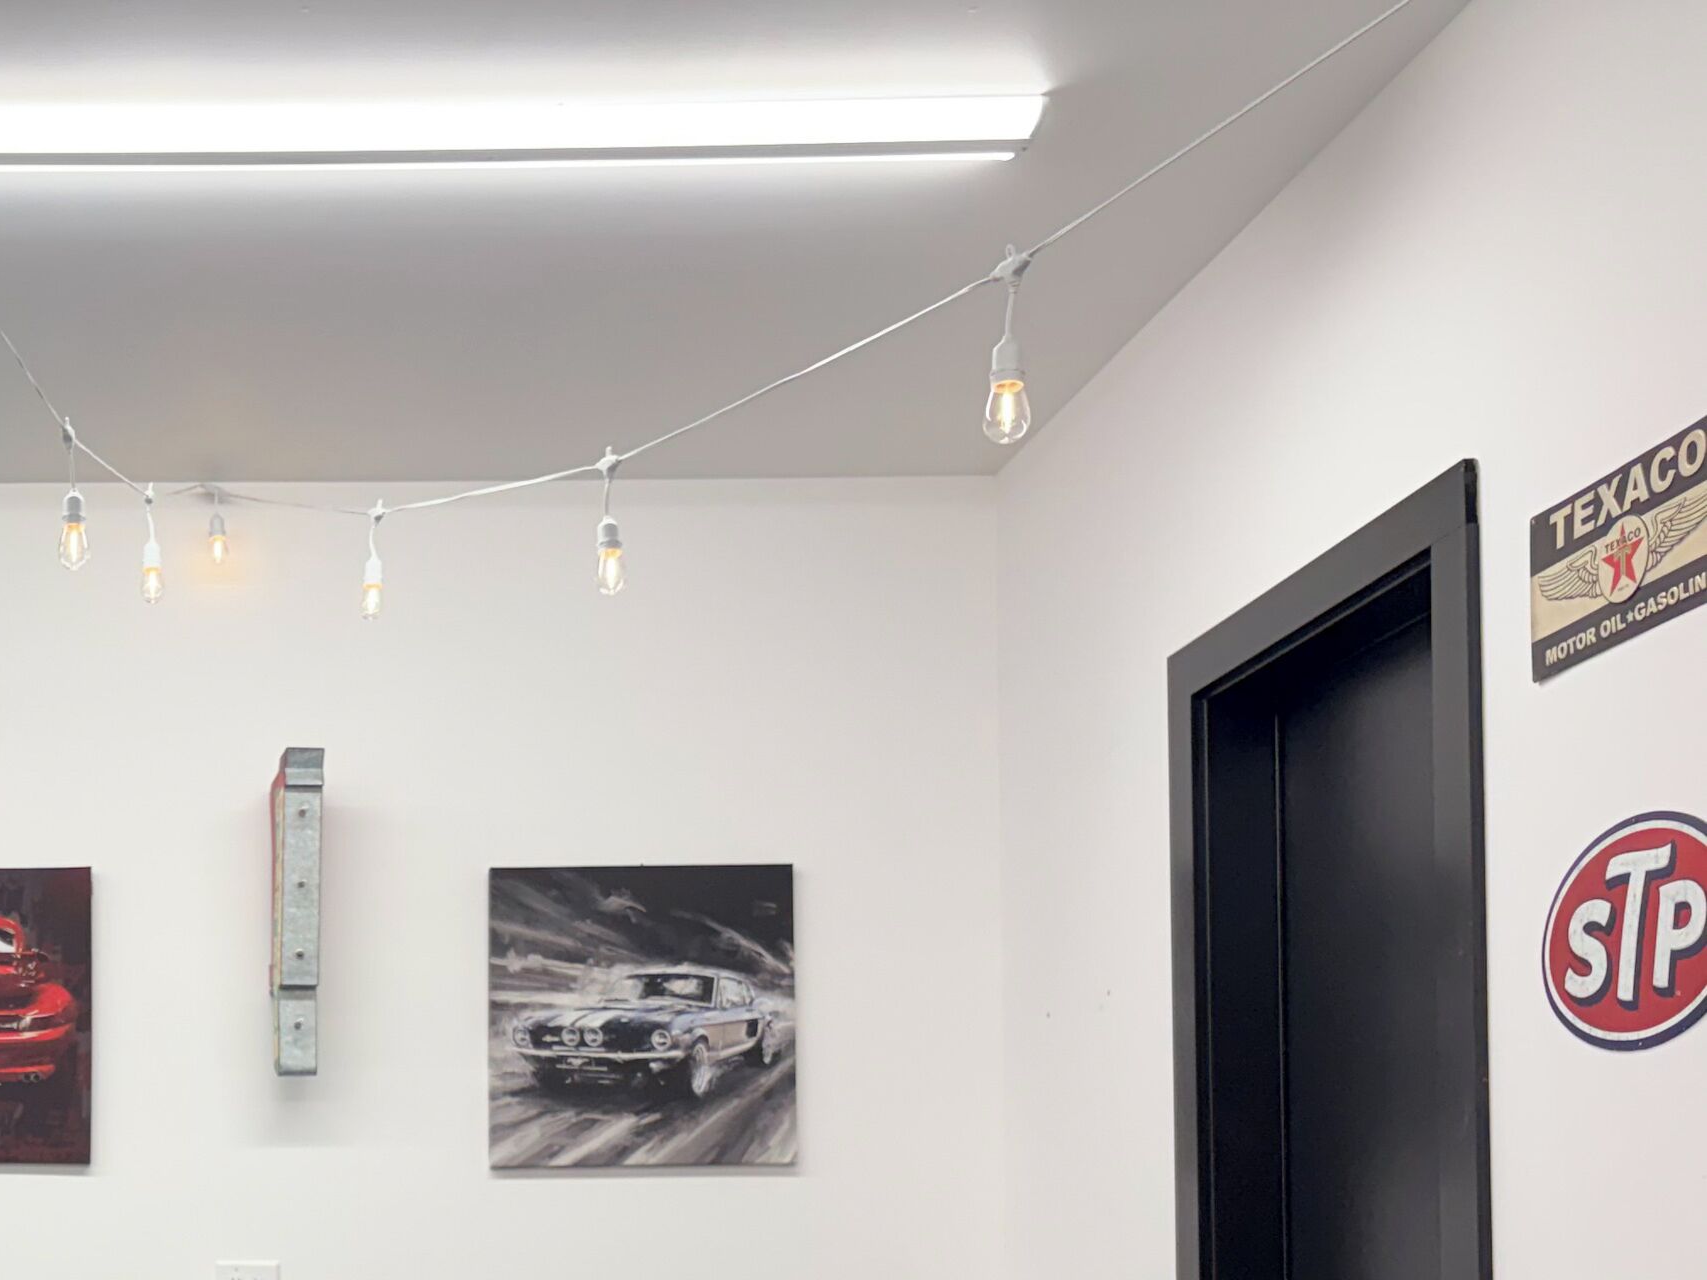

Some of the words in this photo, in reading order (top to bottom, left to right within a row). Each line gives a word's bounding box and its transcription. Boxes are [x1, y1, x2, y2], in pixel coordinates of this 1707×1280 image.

[1549, 428, 1707, 550] TEXACO
[1604, 527, 1641, 554] TEXACO
[1545, 626, 1597, 667] MOTOR
[1600, 614, 1626, 640] OIL
[1564, 841, 1707, 1004] STP
